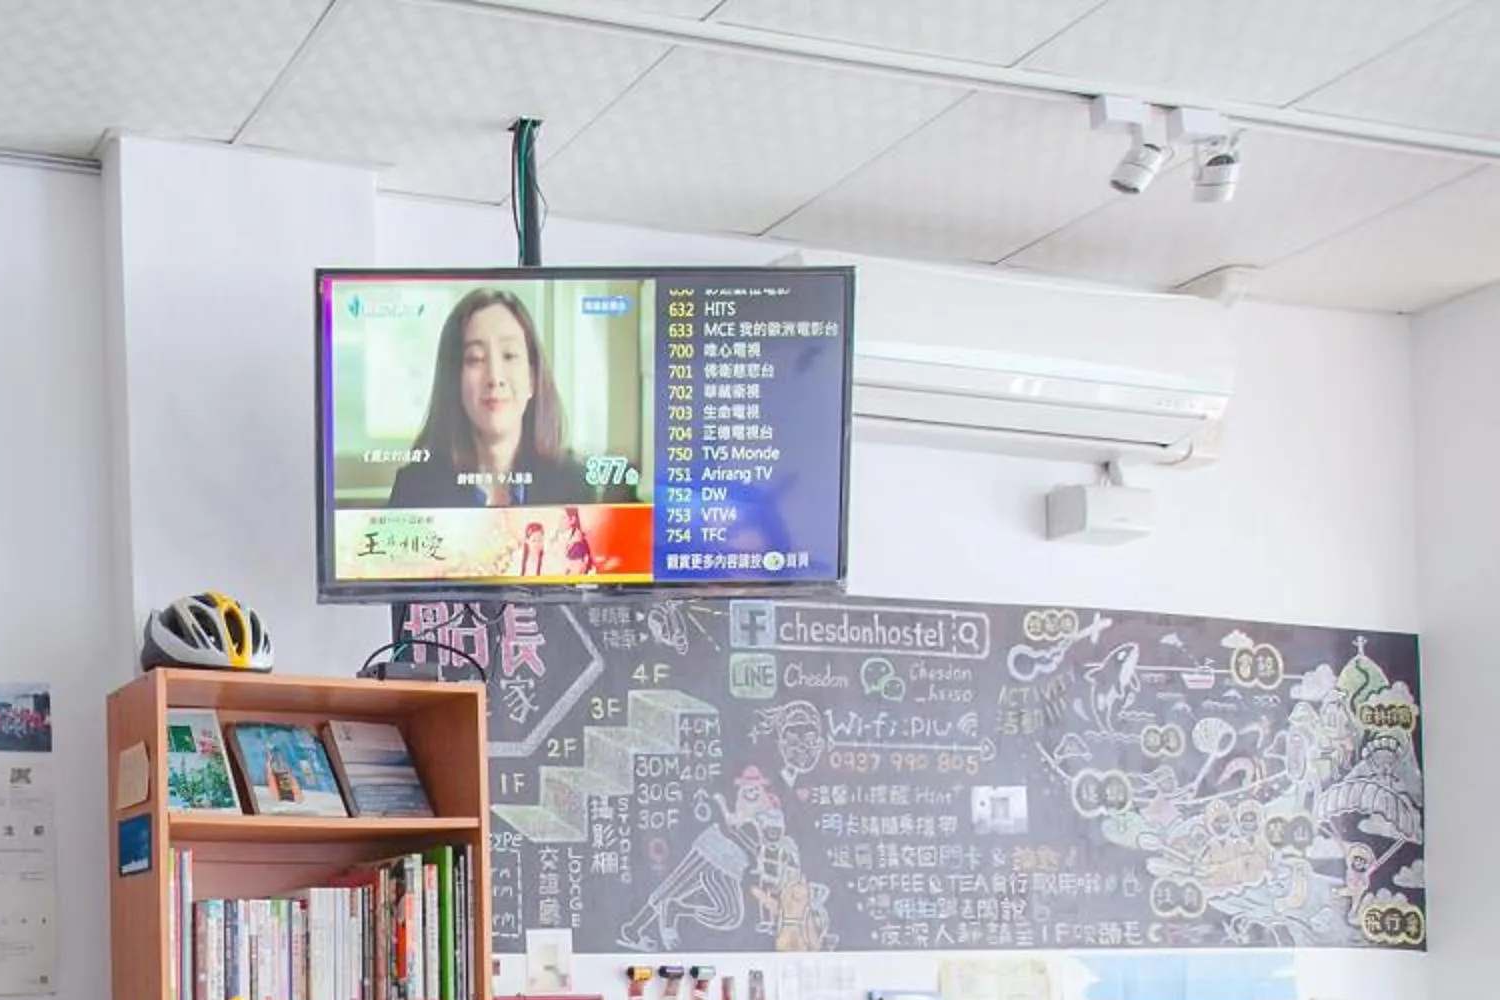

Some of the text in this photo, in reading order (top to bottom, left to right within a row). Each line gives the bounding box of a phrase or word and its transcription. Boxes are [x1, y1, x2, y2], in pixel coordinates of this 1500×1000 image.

[669, 302, 736, 317] 632 HITS
[668, 323, 693, 337] 633
[704, 323, 736, 337] MCE
[668, 344, 694, 358] 700
[668, 365, 693, 379] 701
[668, 385, 693, 400] 702
[668, 405, 693, 420] 703
[668, 426, 693, 441] 704
[667, 446, 781, 461] 750 TV5 Monde
[667, 466, 773, 484] 751 Arirang TV
[667, 487, 728, 502] 752 DW
[666, 507, 737, 522] 753 VTV4
[666, 527, 727, 543] 754 TFC
[778, 611, 946, 648] chesdonhostel
[631, 663, 672, 685] 4F
[733, 664, 775, 688] LINE
[590, 697, 623, 720] 3F
[547, 738, 578, 758] 2F
[636, 755, 680, 778] 30M
[500, 773, 526, 796] 1F
[637, 808, 680, 830] 30F
[857, 873, 925, 893] COFFEE
[945, 874, 989, 894] TEA
